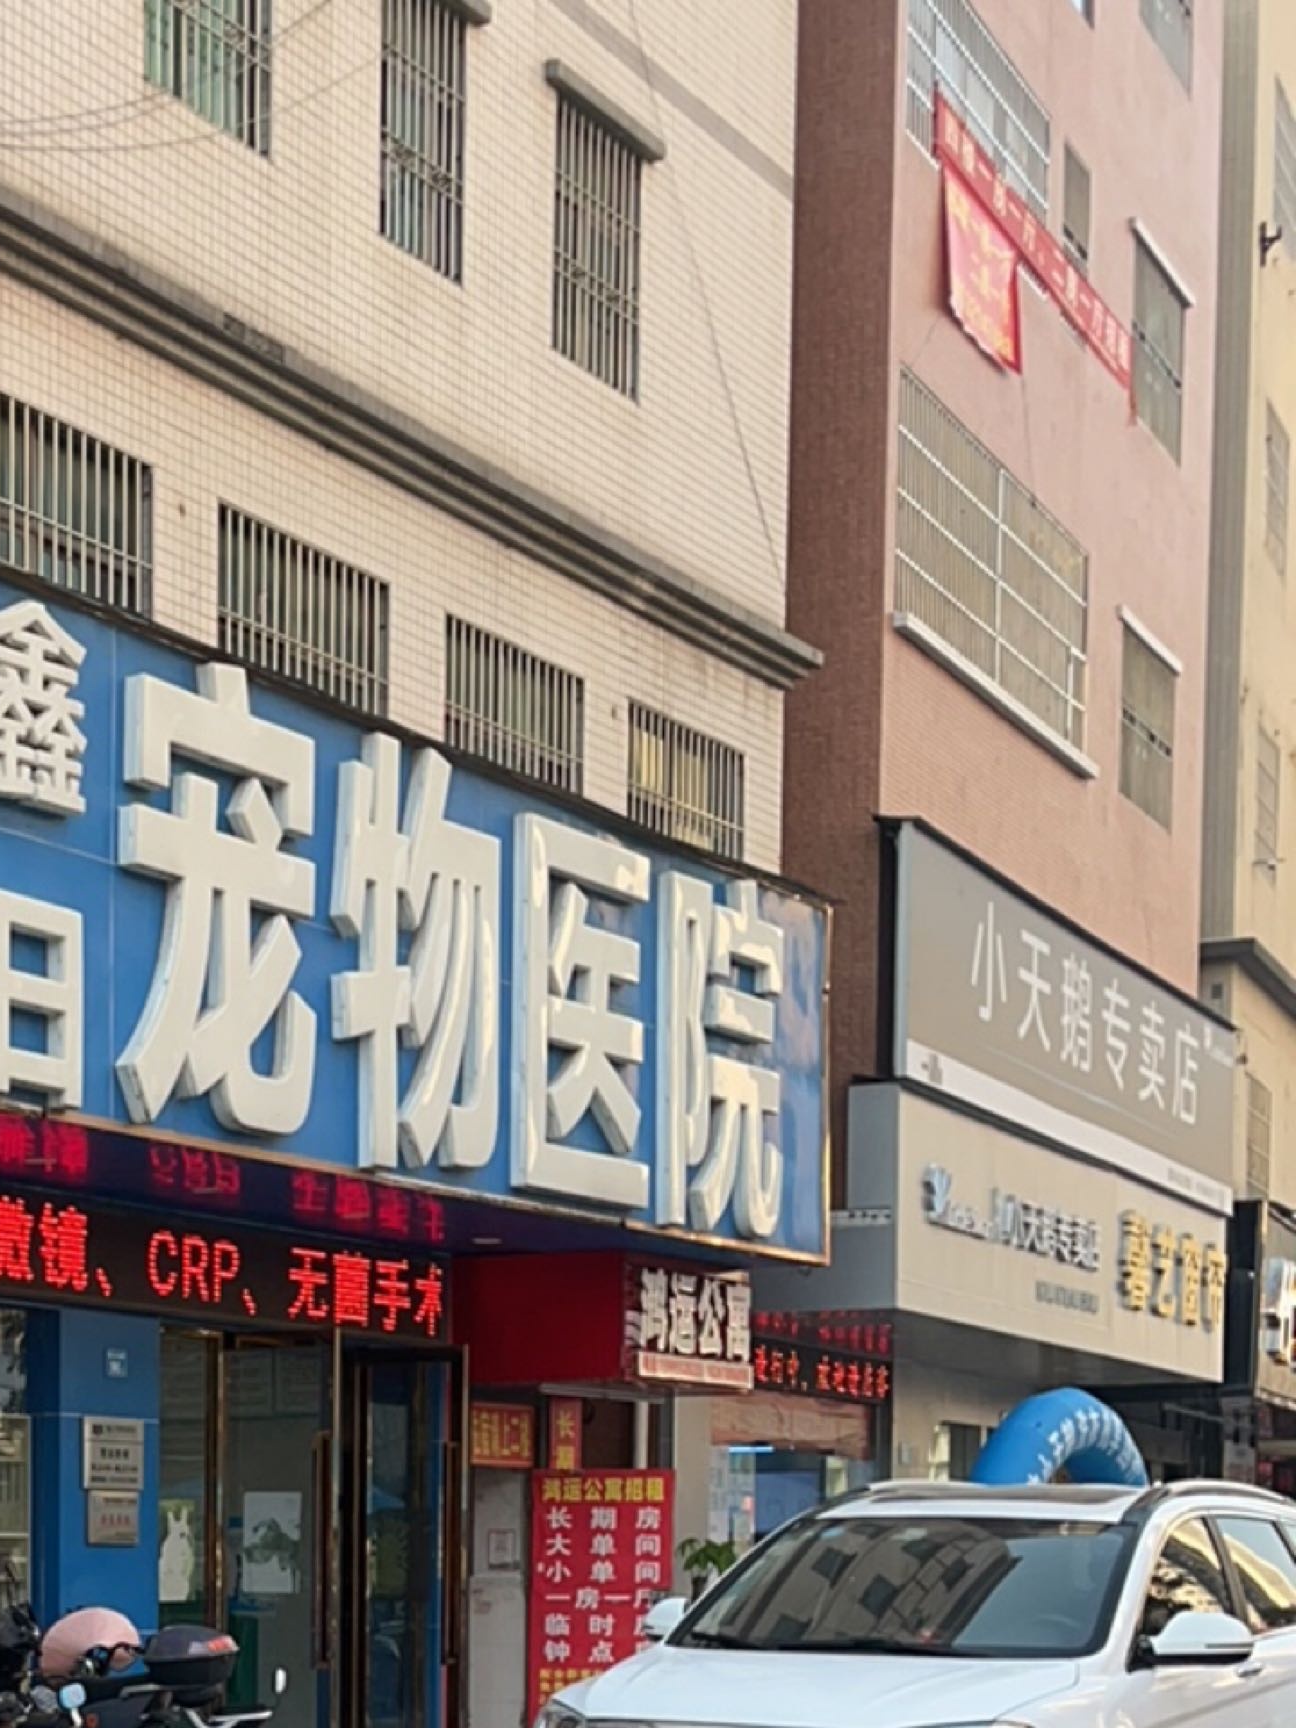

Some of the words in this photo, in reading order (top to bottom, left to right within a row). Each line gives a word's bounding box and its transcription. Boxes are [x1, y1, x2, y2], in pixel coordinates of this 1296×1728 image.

[114, 662, 785, 1240] 宠物医院
[971, 901, 1199, 1127] 小天鹅专卖店
[544, 1640, 650, 1663] 钟点
[545, 1613, 647, 1637] 临时
